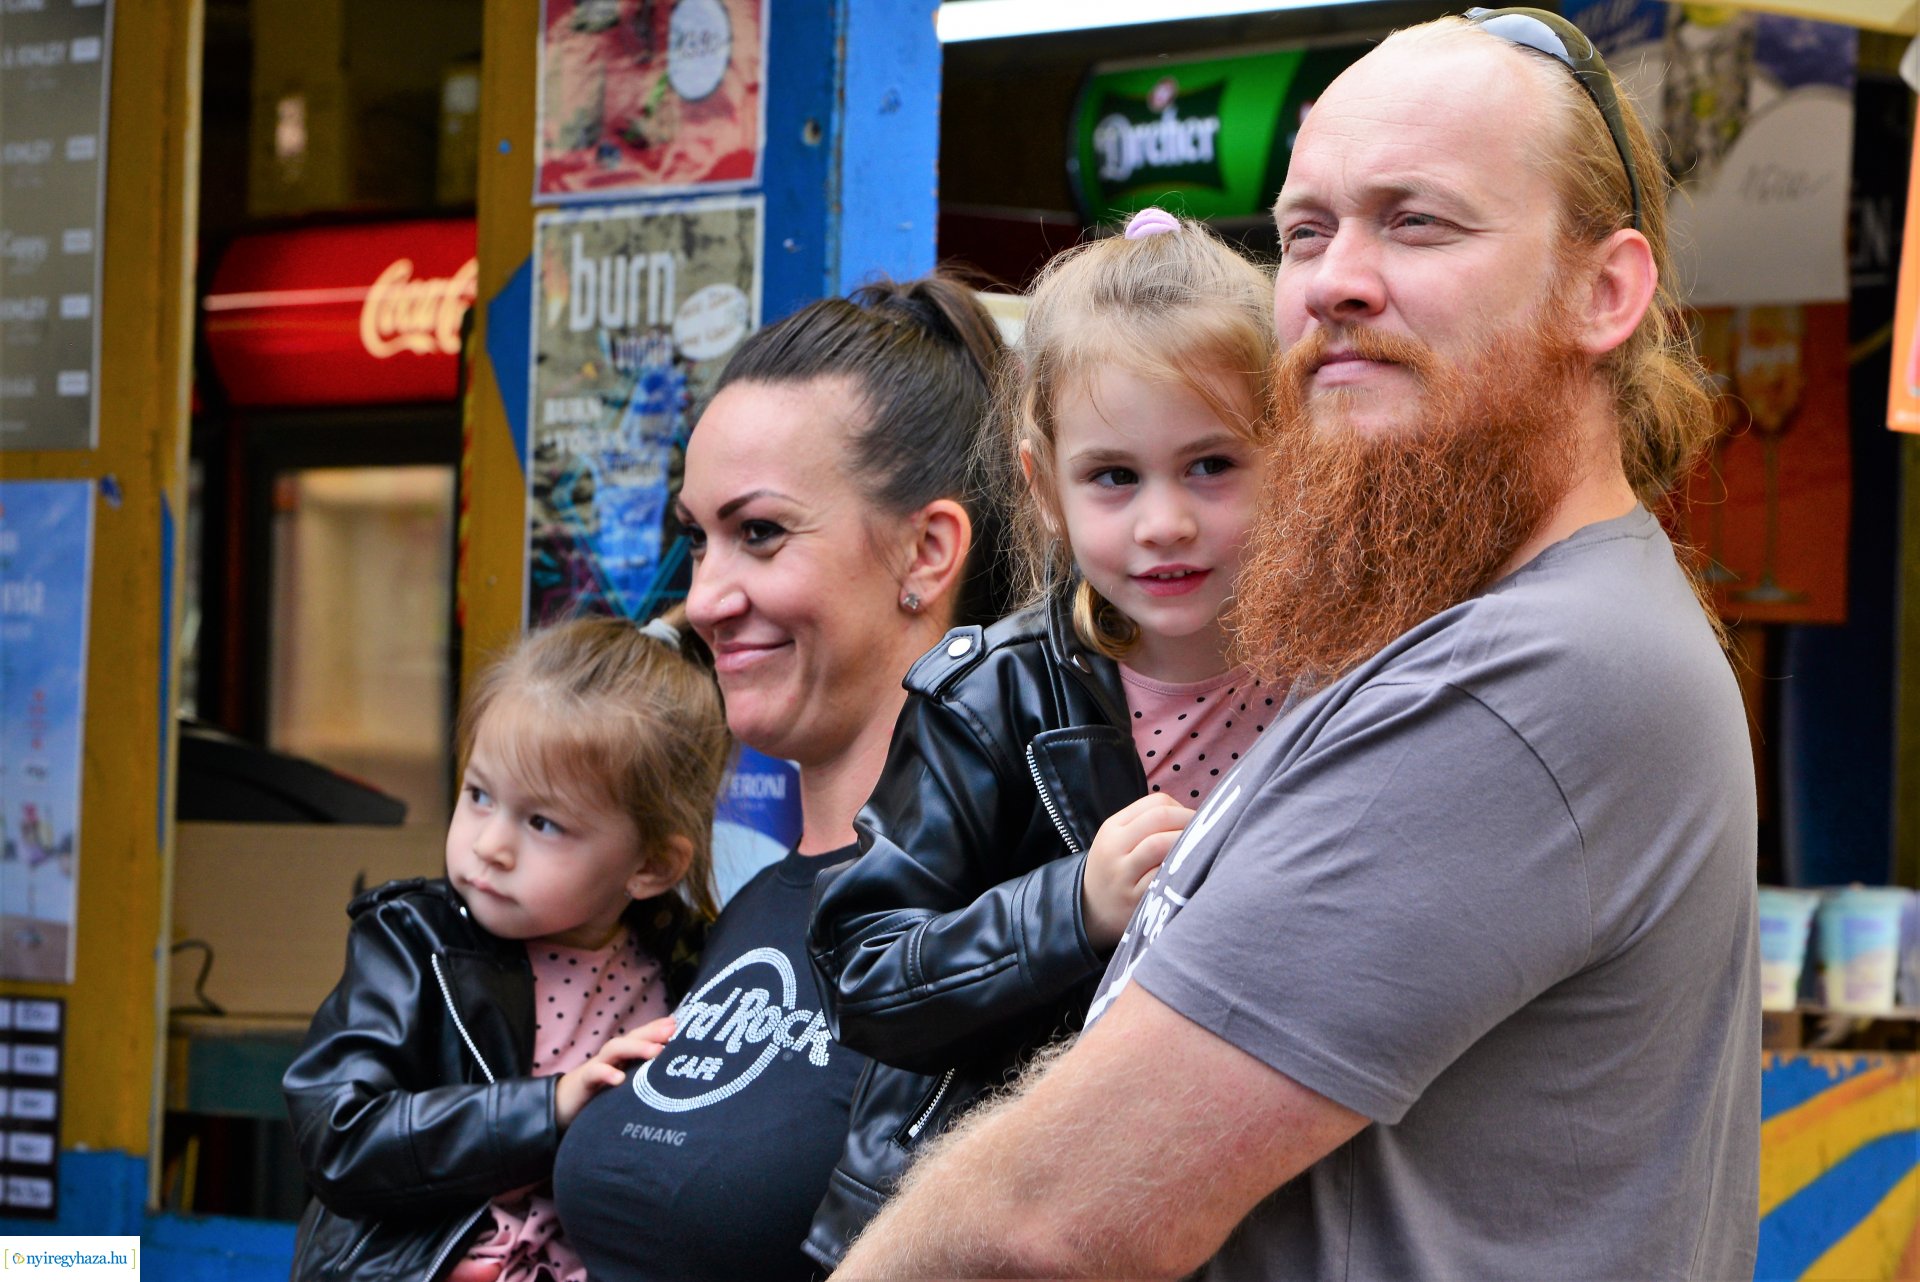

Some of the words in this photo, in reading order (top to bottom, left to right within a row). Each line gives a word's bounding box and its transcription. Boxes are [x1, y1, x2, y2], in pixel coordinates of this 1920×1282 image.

[1092, 106, 1220, 181] Dreher
[570, 232, 677, 332] burn
[668, 987, 743, 1042] rd
[620, 1122, 688, 1147] PENANG
